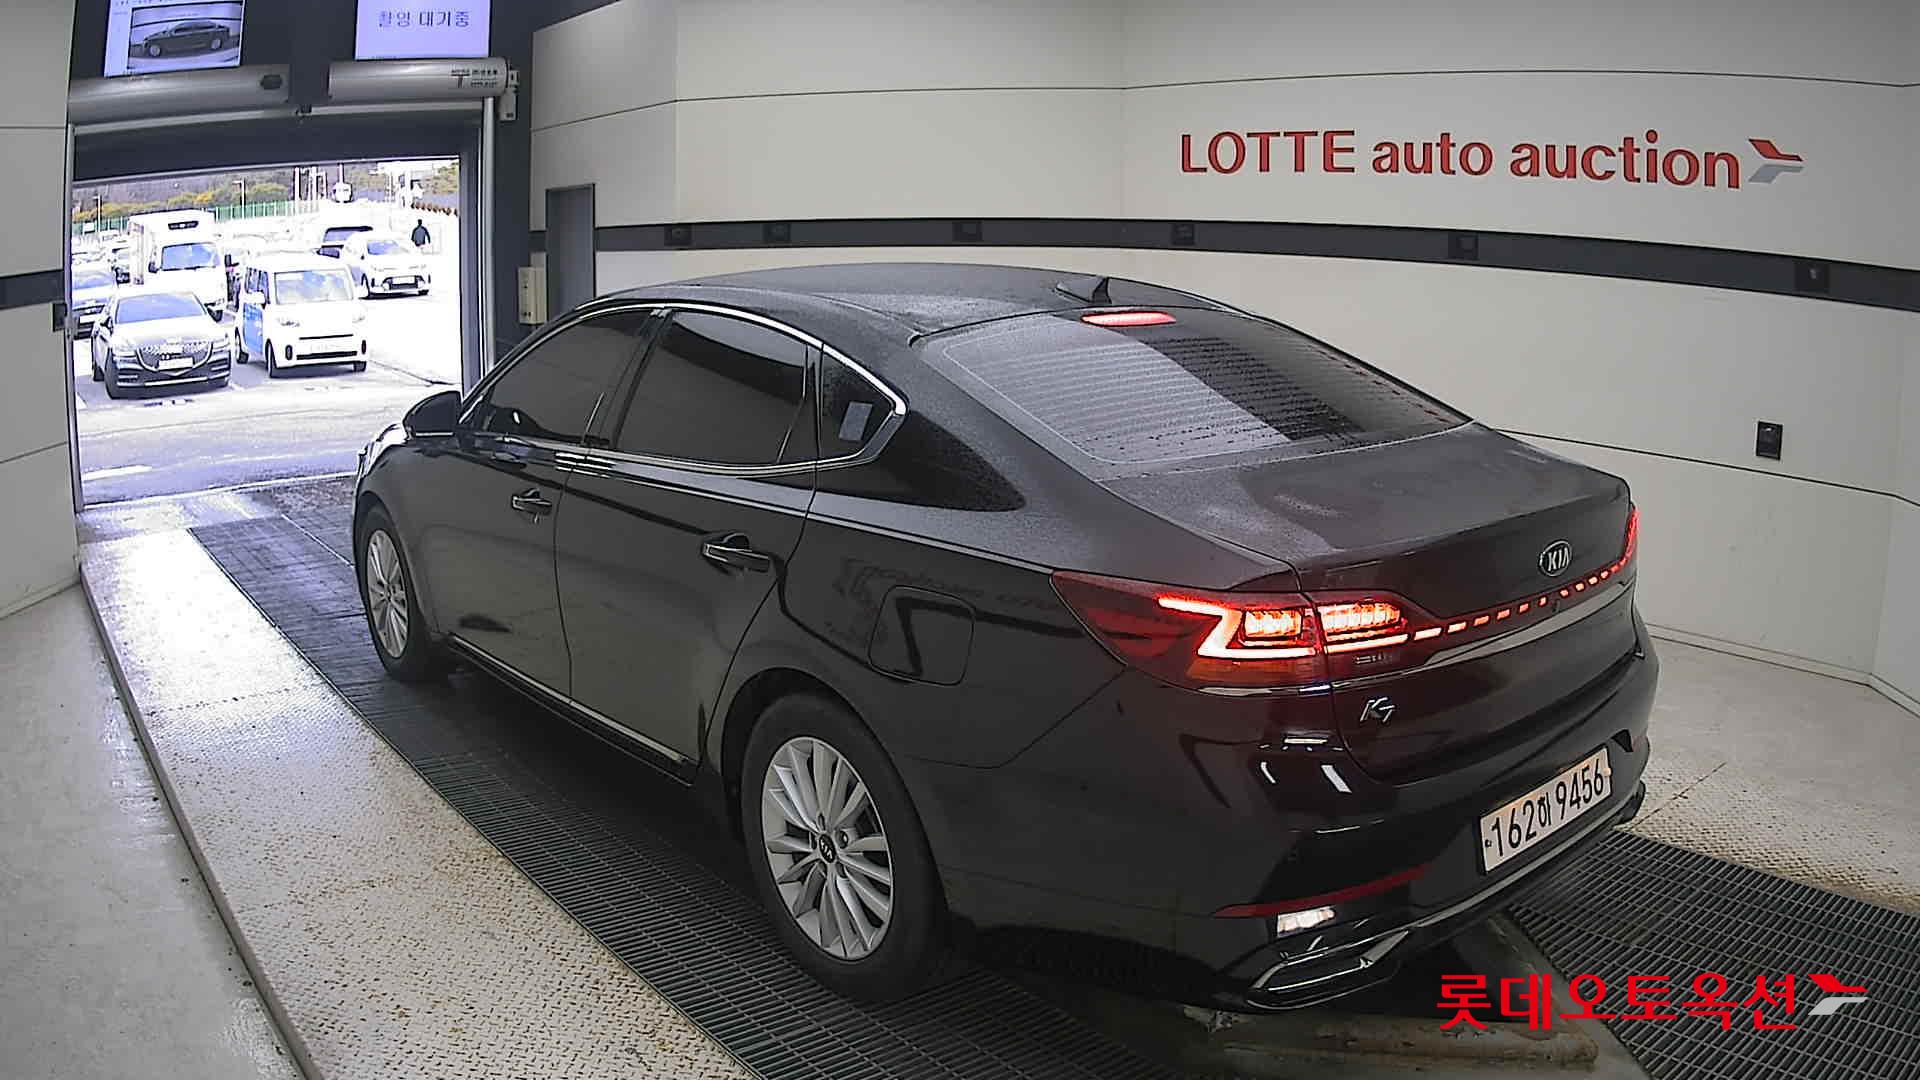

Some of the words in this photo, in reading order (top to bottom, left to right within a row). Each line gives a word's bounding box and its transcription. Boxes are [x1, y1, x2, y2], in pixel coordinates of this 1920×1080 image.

[419, 10, 470, 28] 대기중
[1180, 129, 1356, 174] LOTTE
[1371, 131, 1494, 176] auto
[1509, 128, 1740, 190] auction
[1546, 545, 1571, 573] KIA
[1359, 696, 1397, 723] K7
[1555, 757, 1605, 821] 9456
